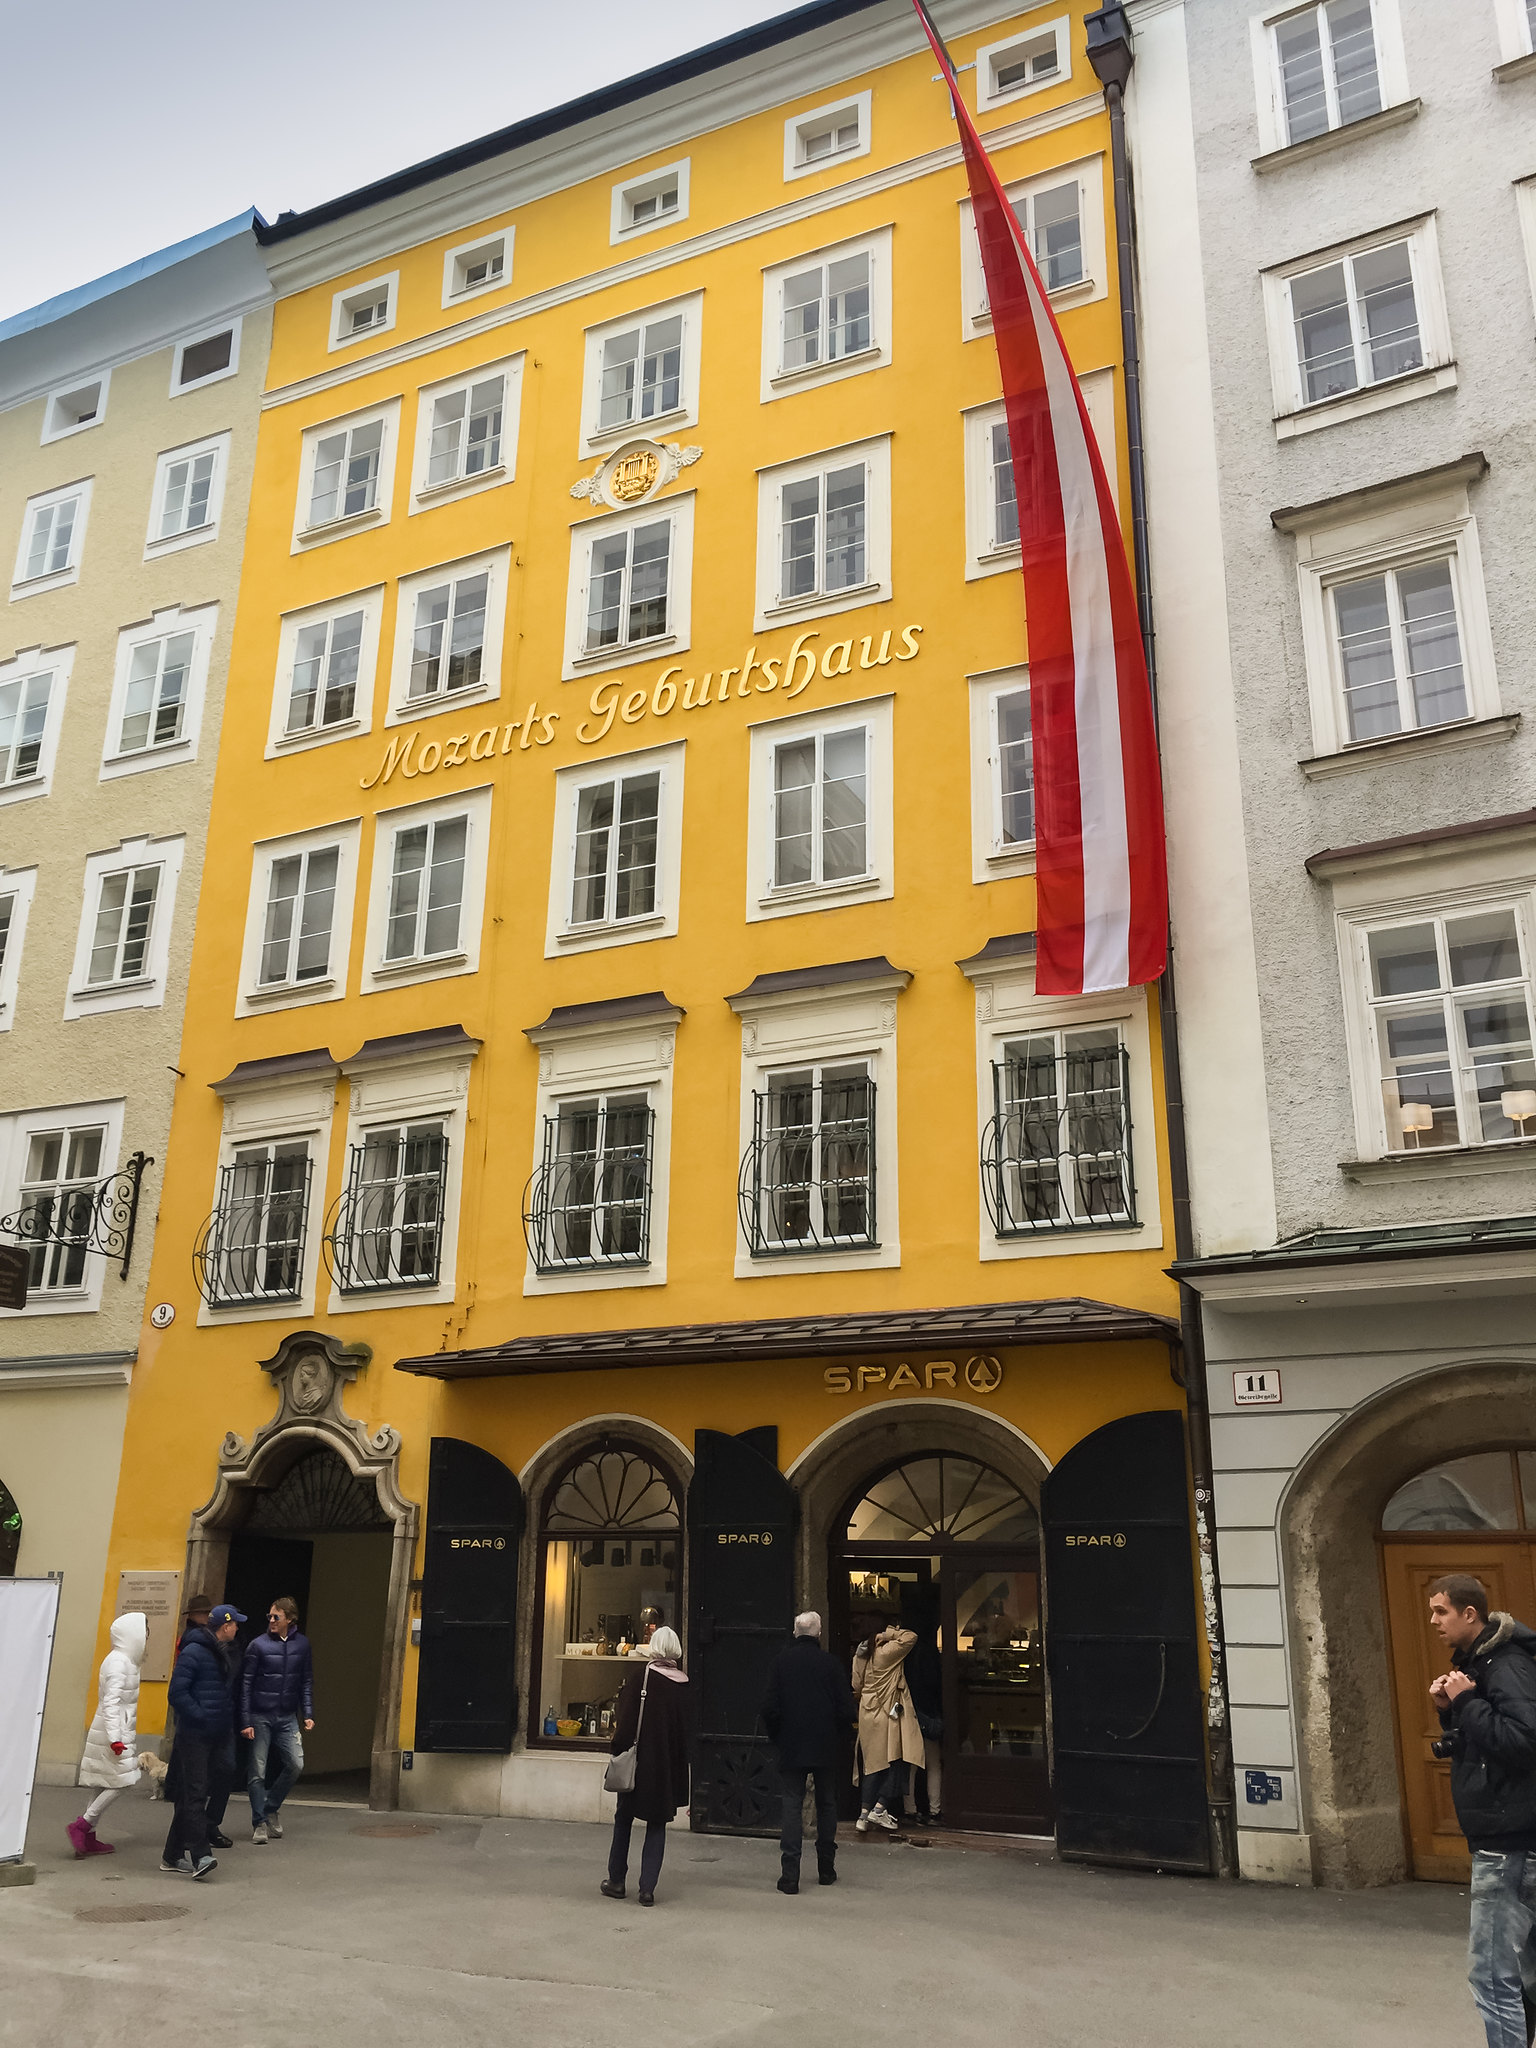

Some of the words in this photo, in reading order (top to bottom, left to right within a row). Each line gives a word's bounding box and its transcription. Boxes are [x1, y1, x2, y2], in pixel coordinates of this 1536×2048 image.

[359, 702, 560, 790] Mozarts
[576, 624, 923, 744] Geburtshaus
[159, 1305, 167, 1321] 9
[823, 1360, 957, 1394] SPAR
[1244, 1374, 1269, 1393] 11
[450, 1539, 493, 1549] SPAR
[718, 1533, 760, 1545] SPAR
[1065, 1535, 1112, 1547] SPAR
[224, 1612, 232, 1621] 3
